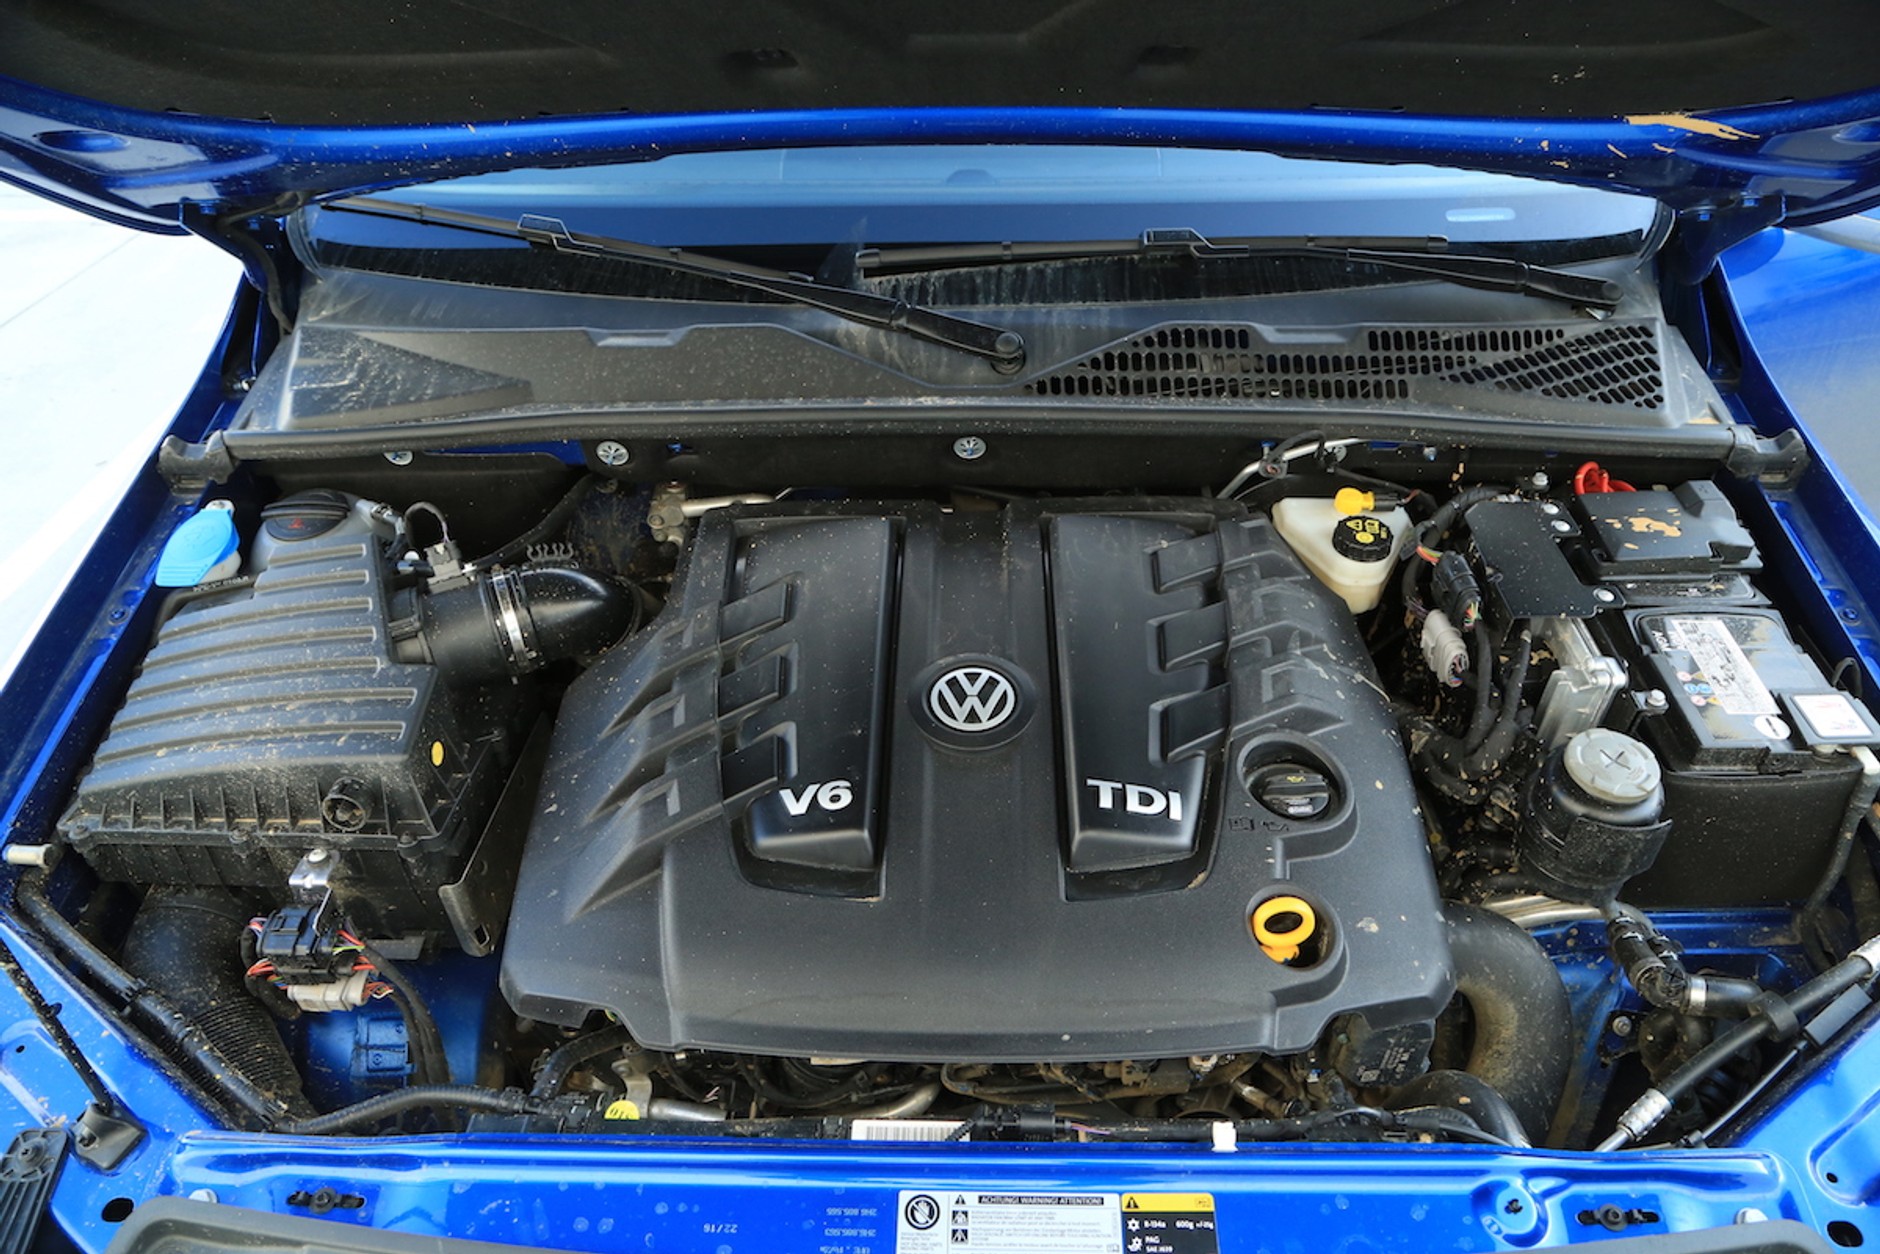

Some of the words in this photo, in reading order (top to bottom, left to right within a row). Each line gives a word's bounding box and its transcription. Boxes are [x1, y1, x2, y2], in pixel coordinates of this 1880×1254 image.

[930, 667, 1015, 731] VW
[779, 780, 853, 816] V6
[1086, 779, 1182, 821] TDI
